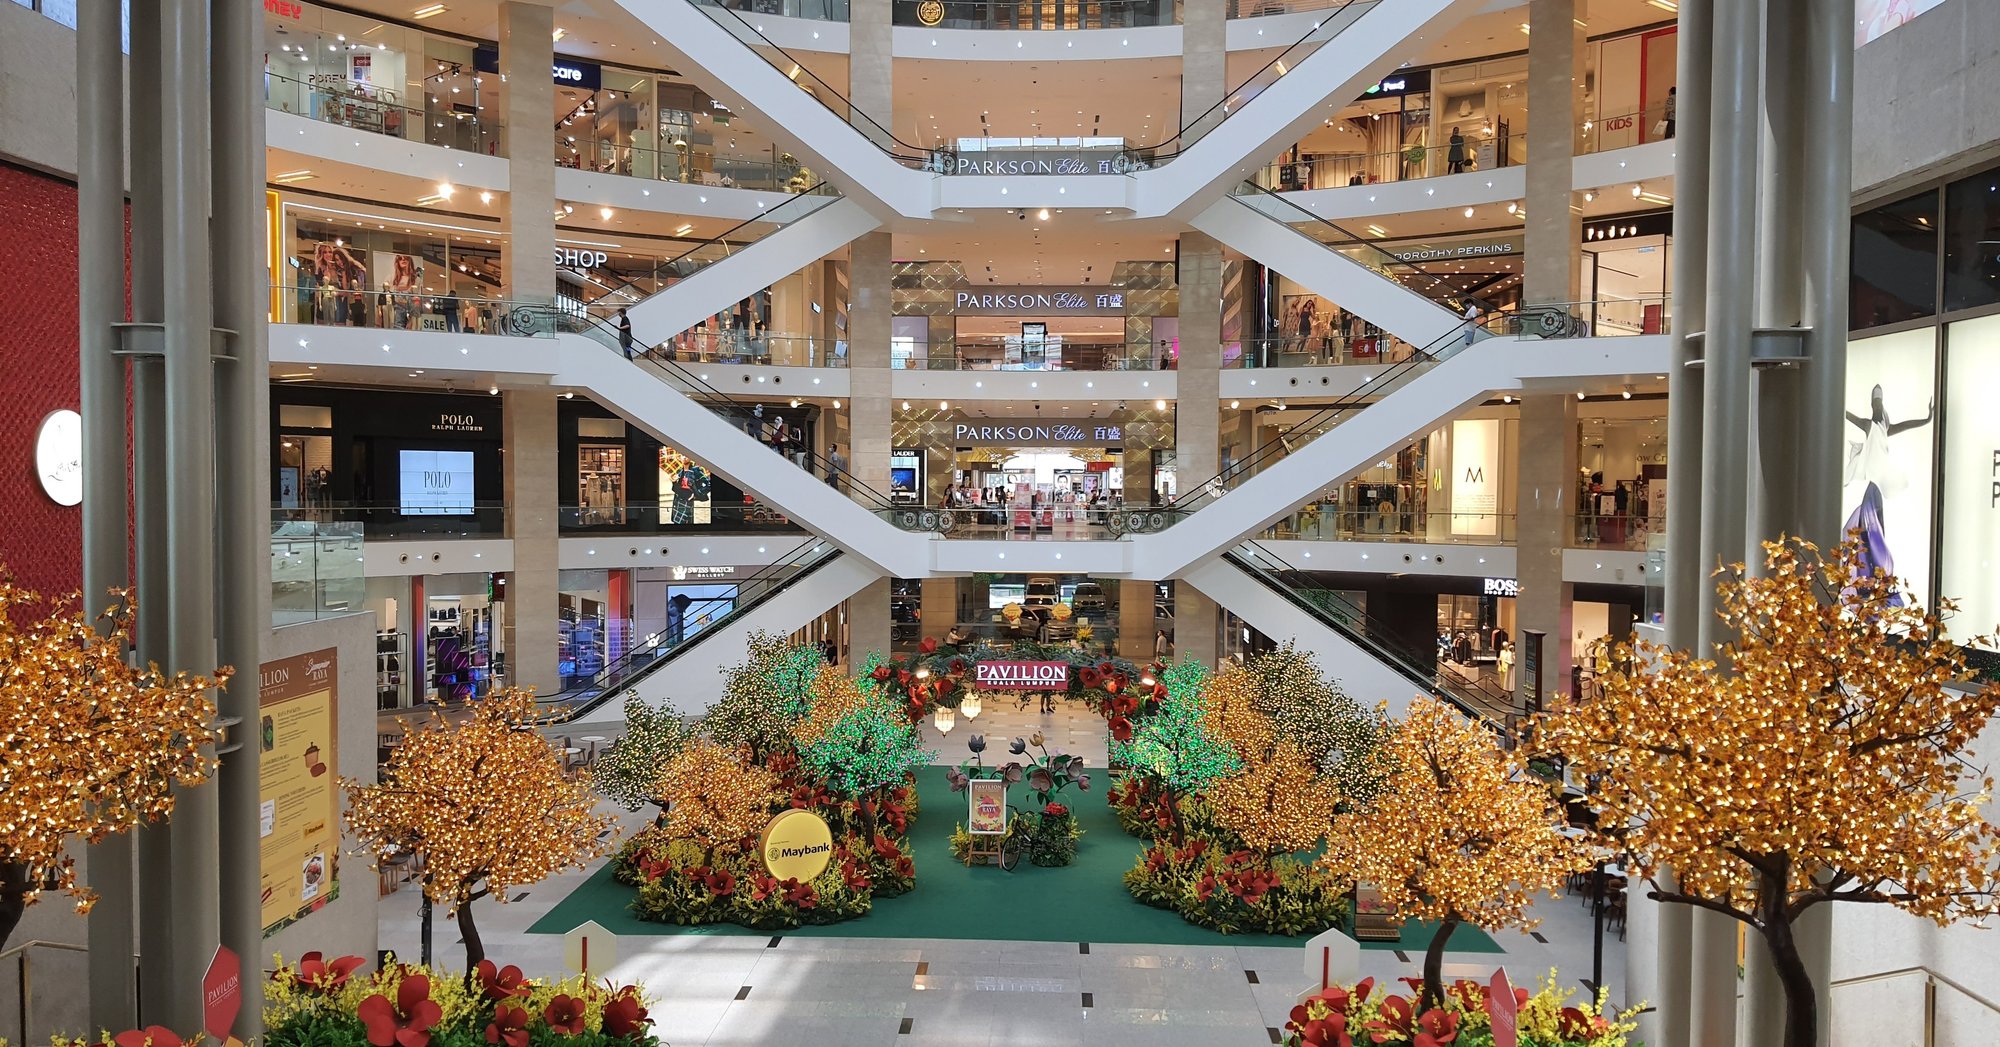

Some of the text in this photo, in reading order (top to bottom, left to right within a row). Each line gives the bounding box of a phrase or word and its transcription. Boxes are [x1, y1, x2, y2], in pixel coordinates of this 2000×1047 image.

[553, 65, 582, 81] care
[1606, 117, 1633, 132] KIDS
[958, 158, 1090, 174] PARKSON Elite
[555, 247, 608, 269] SHOP
[1394, 243, 1512, 261] DOROTHY PERKINS
[957, 292, 1089, 309] PARKSON Elite
[1095, 293, 1123, 309] 百盛
[423, 318, 446, 331] SALE
[441, 414, 474, 426] POLO
[956, 424, 1087, 441] PARKSON Elite
[1094, 426, 1121, 441] 百盛
[424, 471, 452, 489] POLO
[1465, 467, 1483, 484] M
[977, 664, 1066, 679] PAVILION
[781, 842, 830, 858] Maybank
[208, 973, 239, 1003] PAVILION
